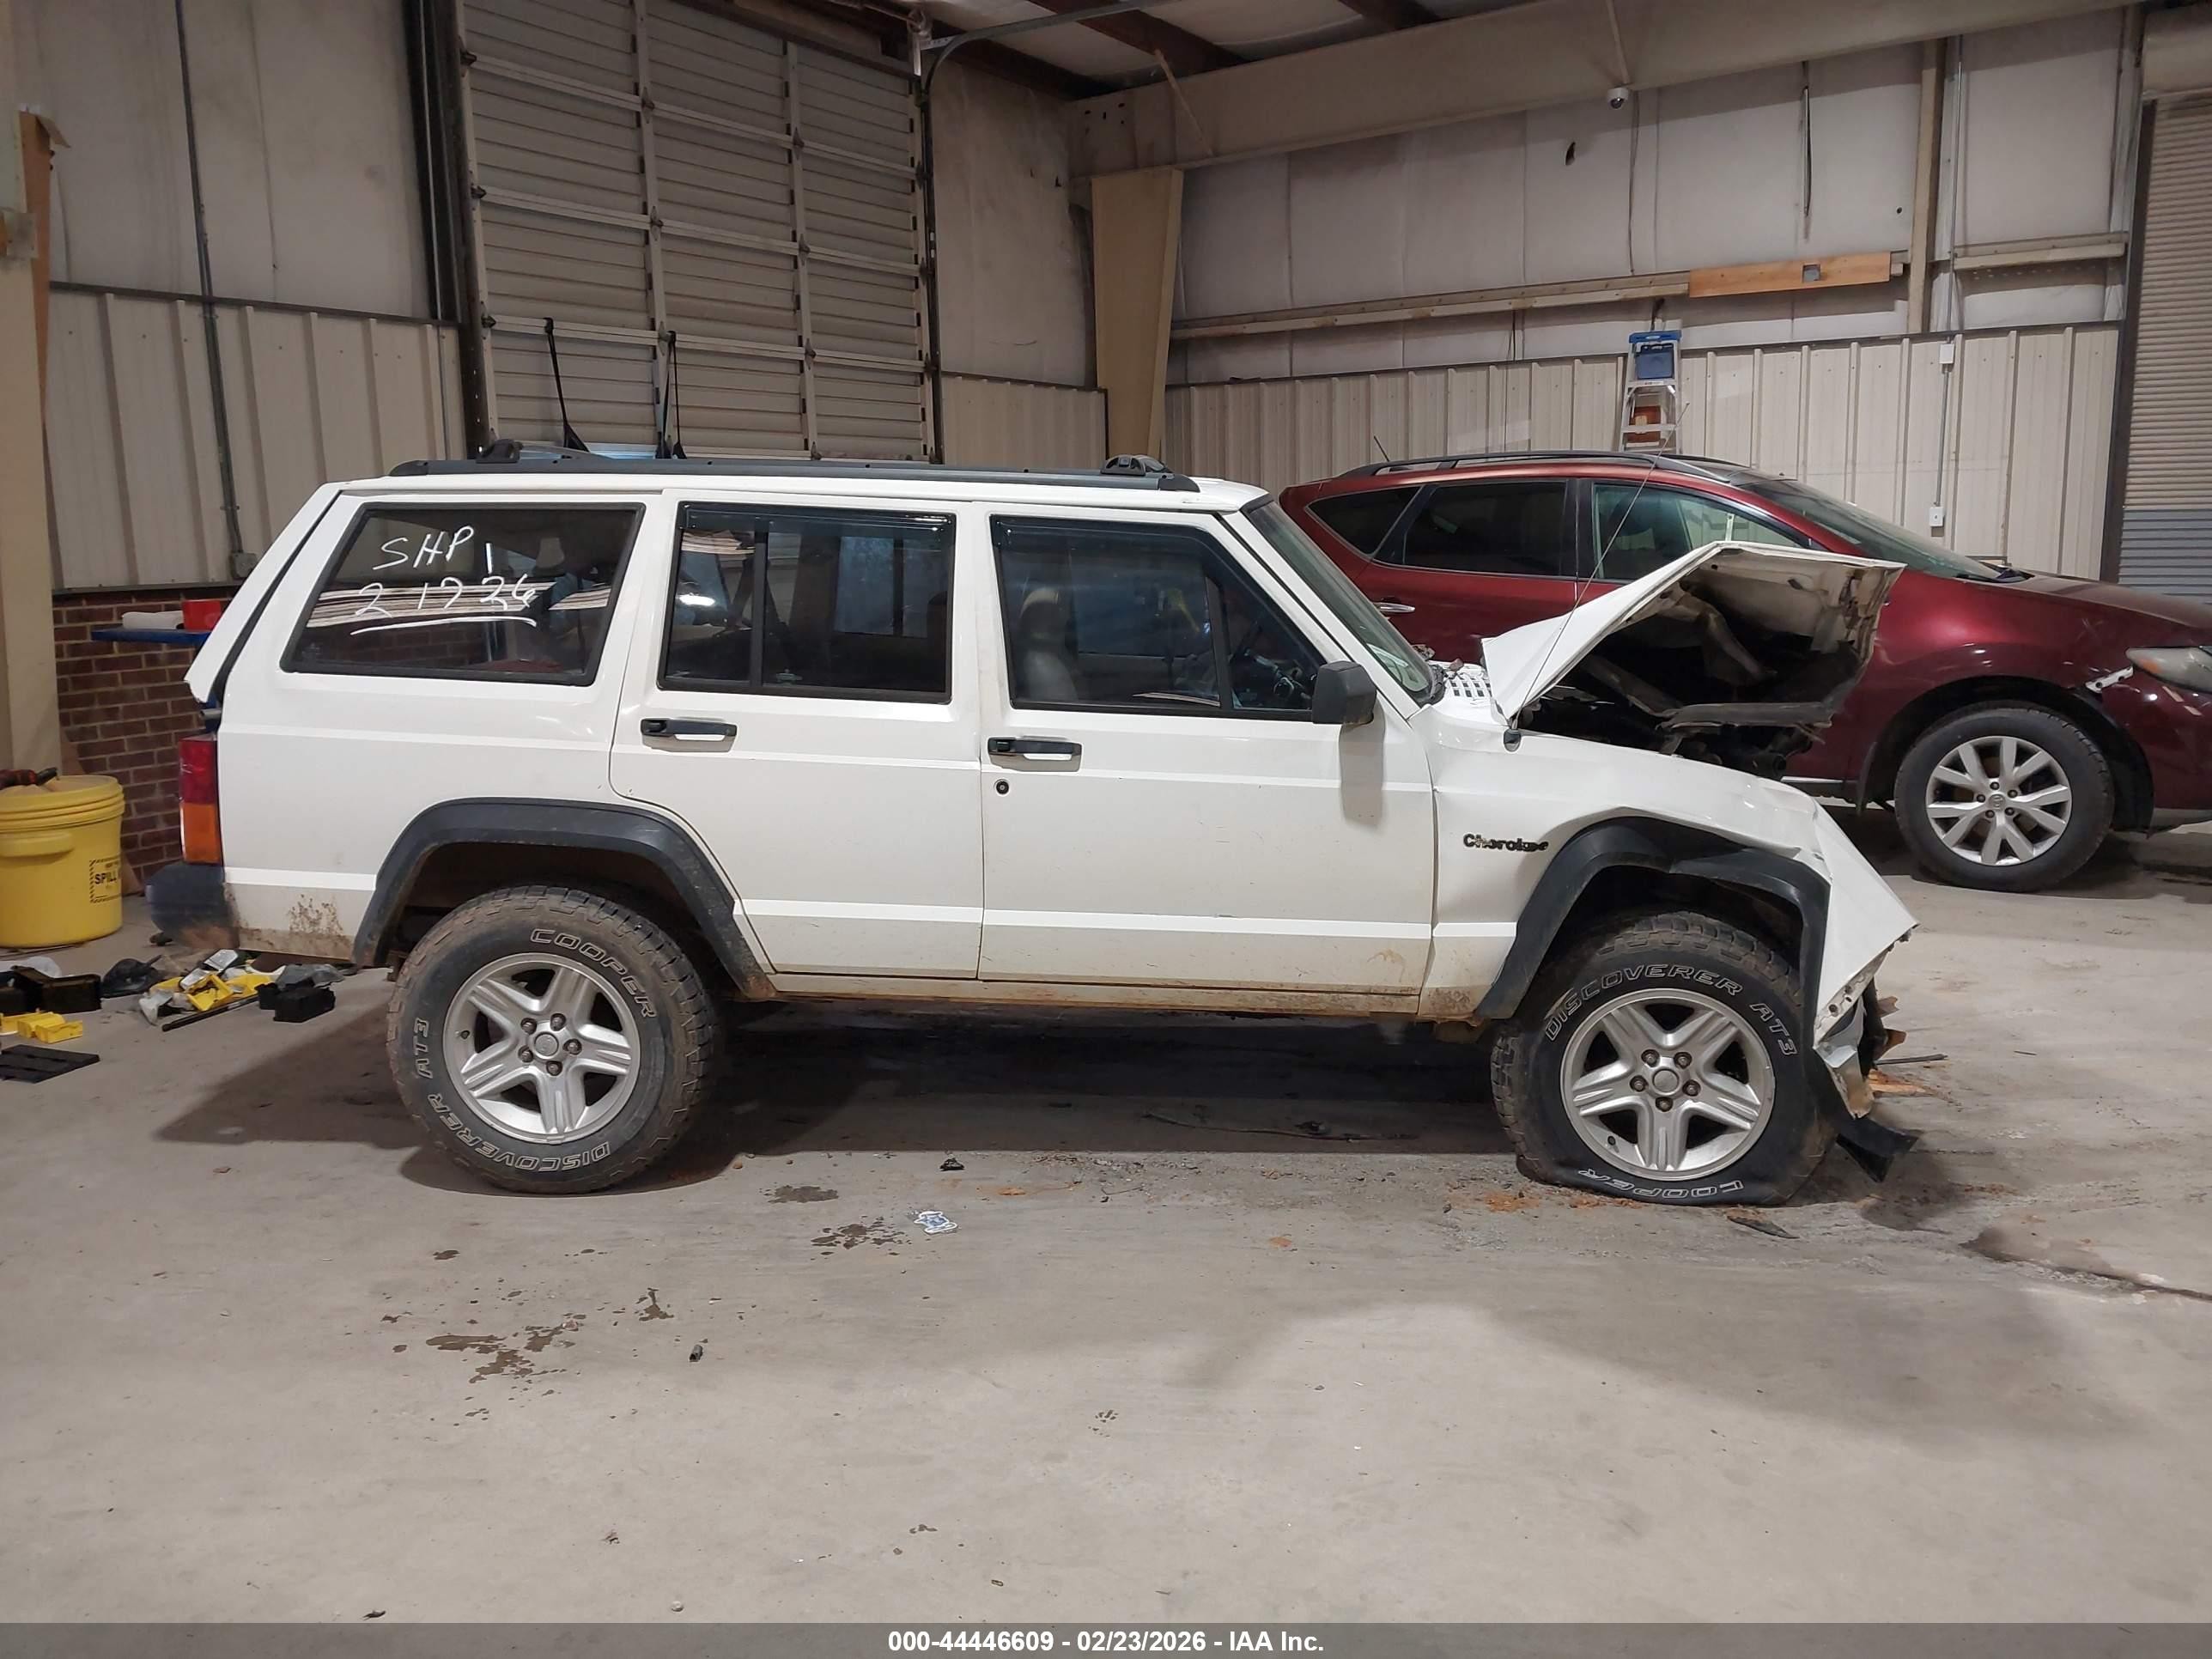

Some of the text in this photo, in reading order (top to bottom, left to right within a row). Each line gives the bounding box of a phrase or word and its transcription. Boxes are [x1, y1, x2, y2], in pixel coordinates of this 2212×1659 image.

[372, 526, 474, 570] SHP
[355, 582, 393, 618] 2
[479, 573, 537, 611] 26
[1462, 833, 1549, 852] Cherokee
[530, 927, 657, 1018] COOPER
[1545, 963, 1798, 1057] DISCOVERER AT3
[428, 1092, 611, 1173] DISCOVERER
[1577, 1168, 1744, 1199] COOPER
